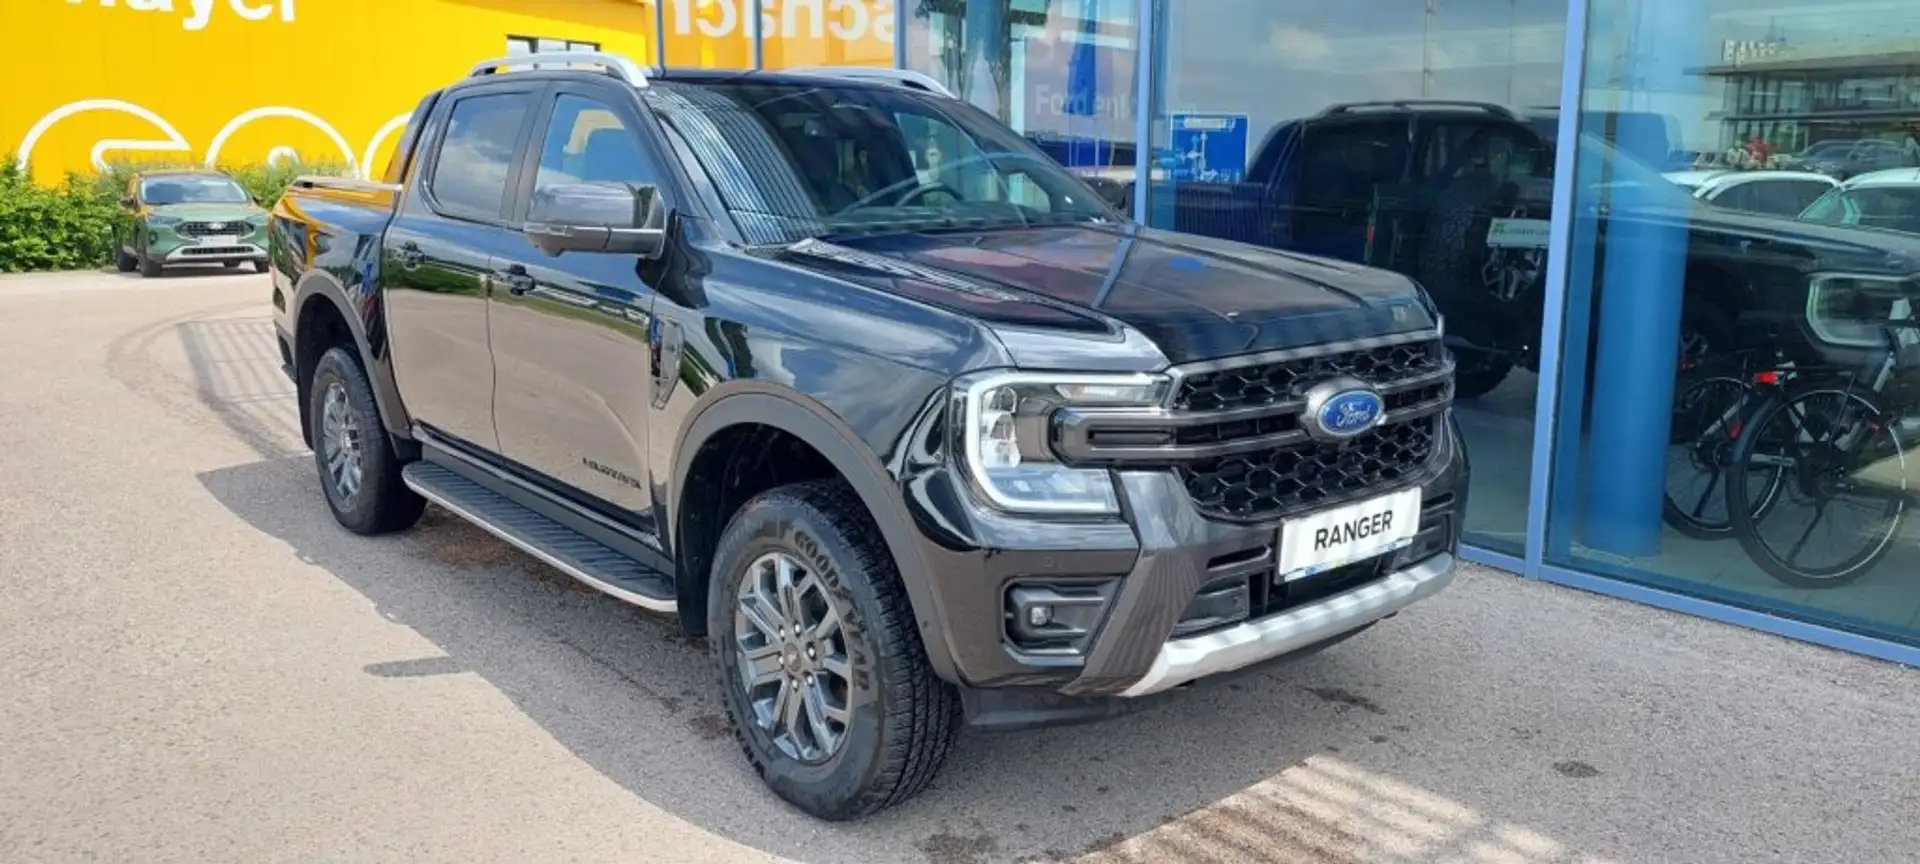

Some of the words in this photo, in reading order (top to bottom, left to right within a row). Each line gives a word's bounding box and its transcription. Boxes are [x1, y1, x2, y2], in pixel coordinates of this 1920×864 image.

[1034, 83, 1088, 116] Ford
[1095, 91, 1128, 120] ent
[1314, 509, 1393, 551] RANGER
